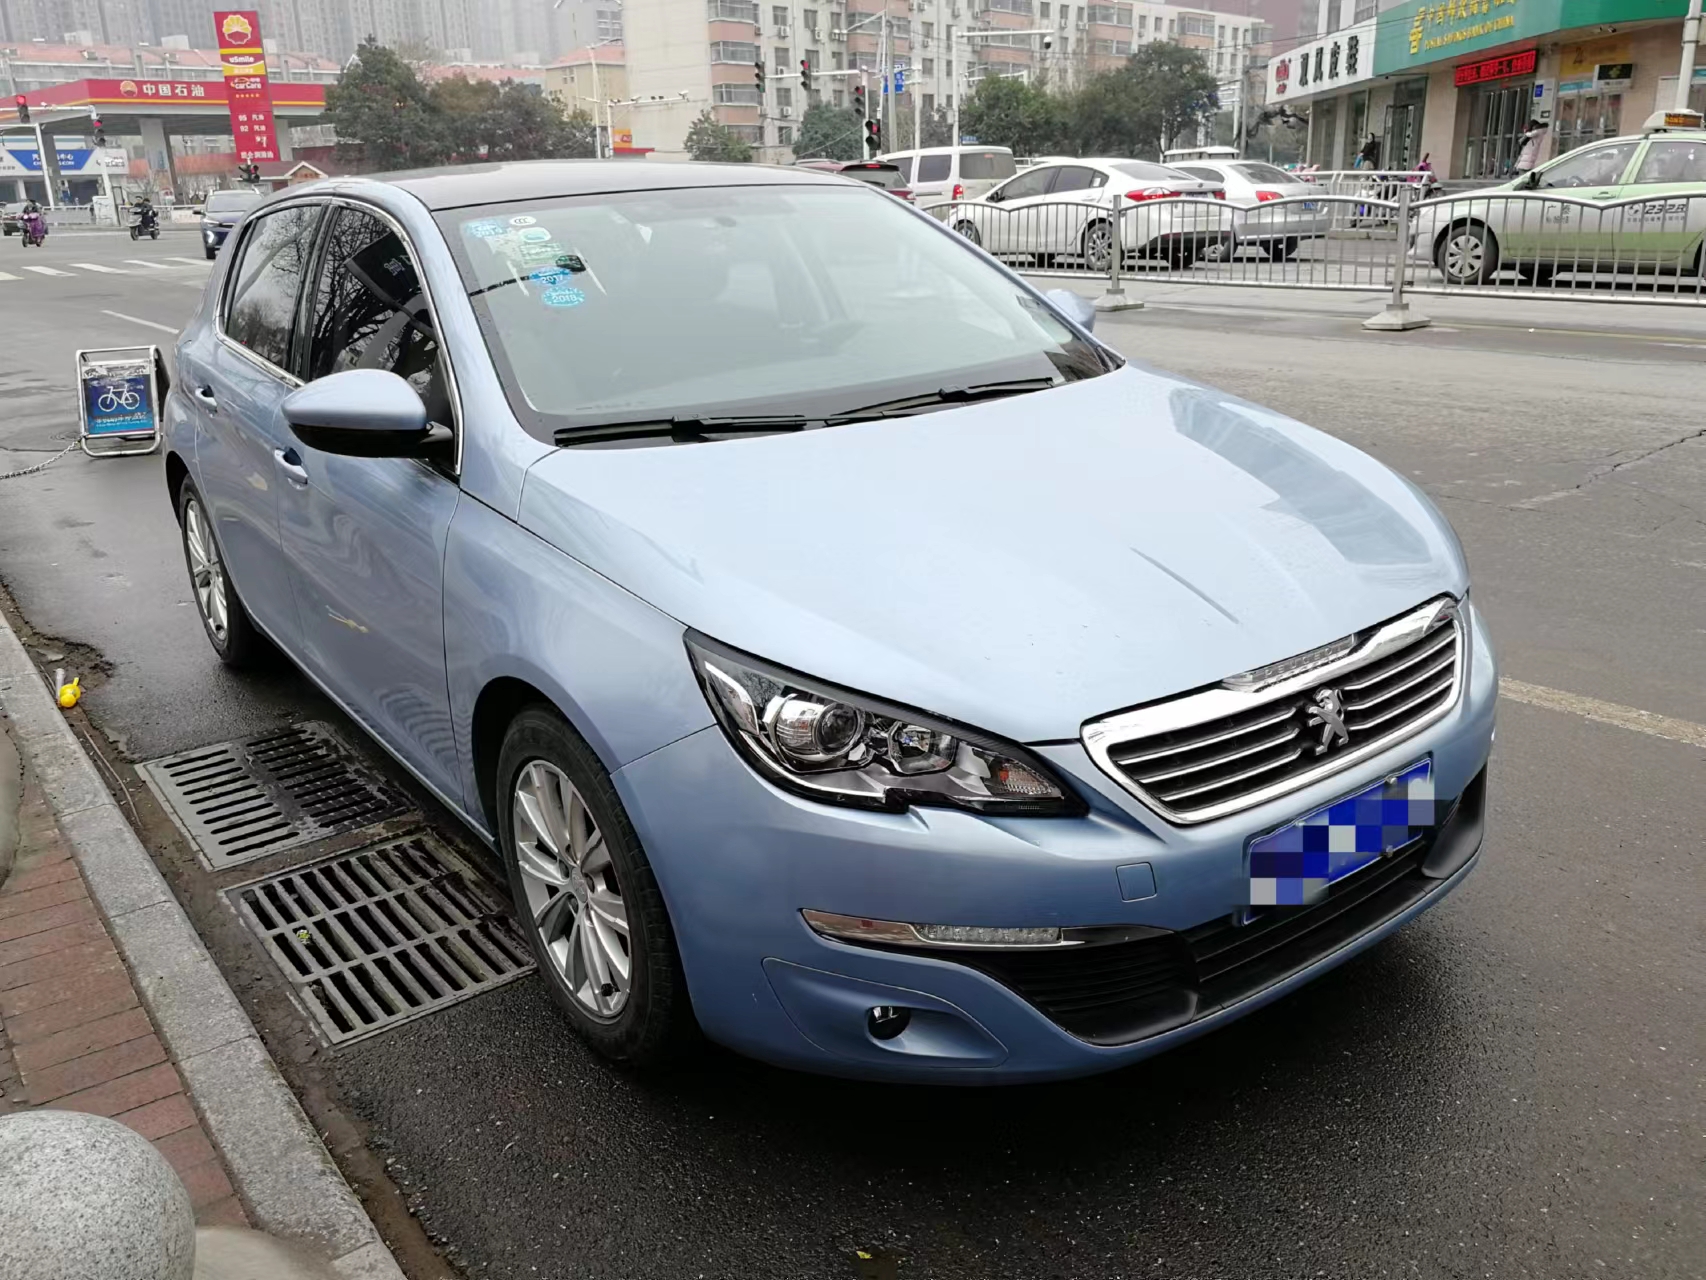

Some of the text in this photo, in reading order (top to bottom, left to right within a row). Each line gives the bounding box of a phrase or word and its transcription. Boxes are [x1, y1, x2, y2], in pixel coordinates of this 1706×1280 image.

[142, 83, 205, 96] 中国石油
[552, 294, 578, 303] 2018
